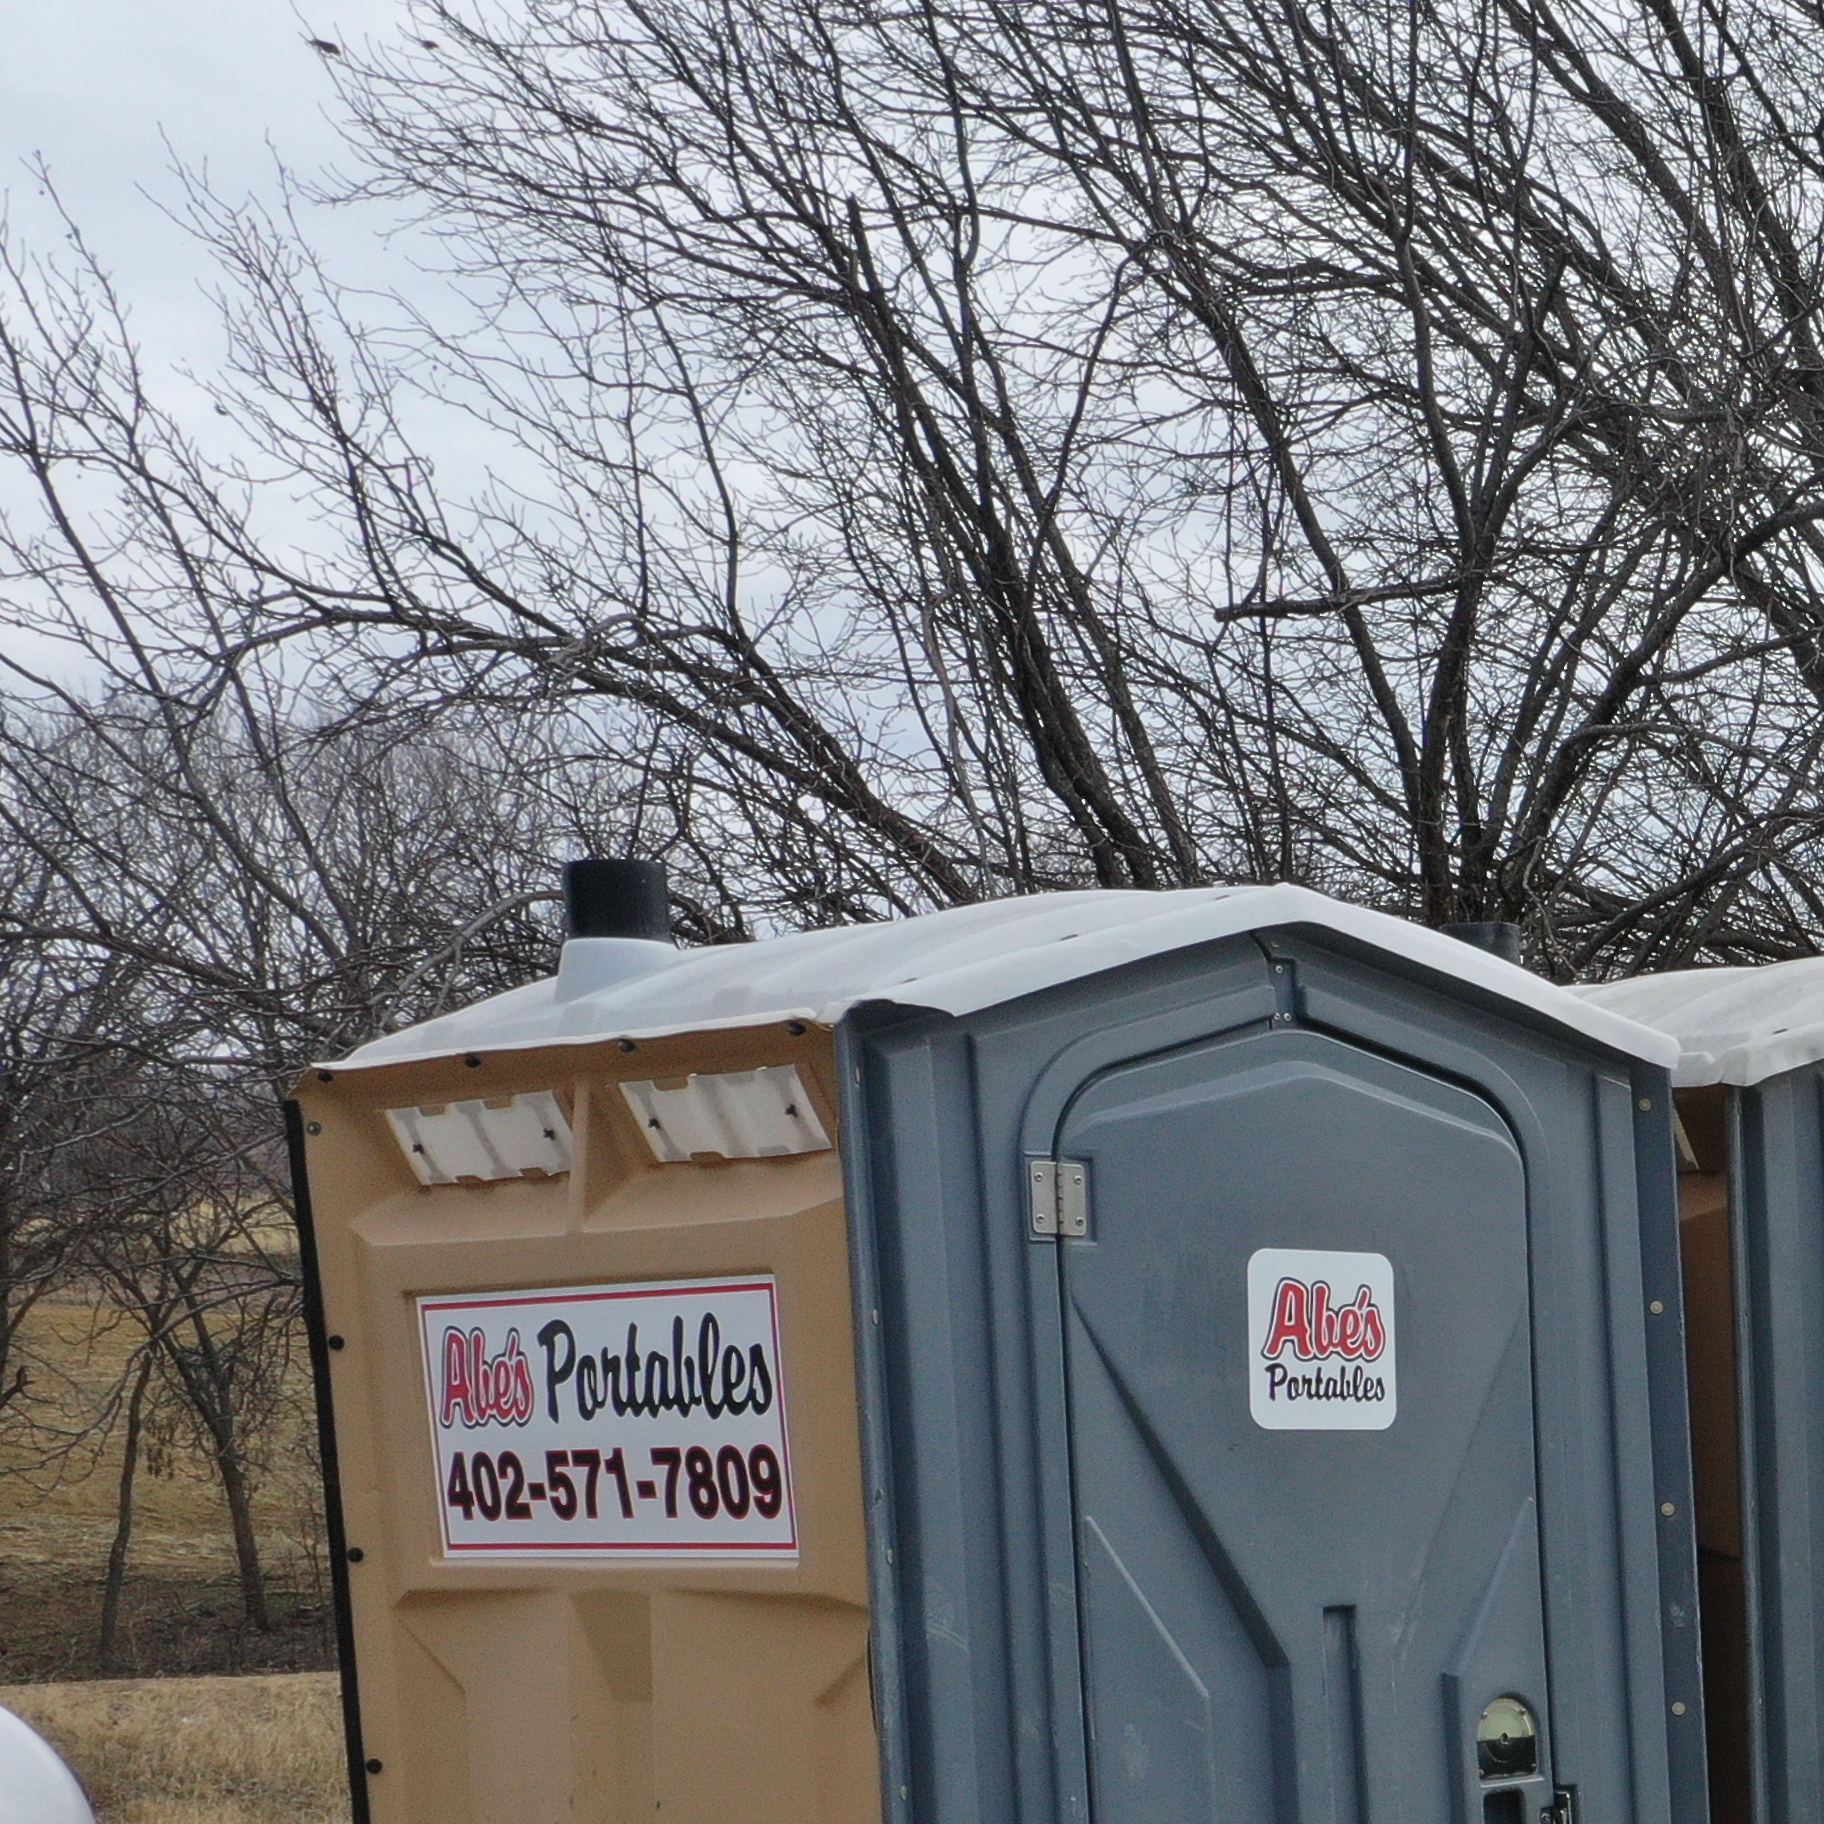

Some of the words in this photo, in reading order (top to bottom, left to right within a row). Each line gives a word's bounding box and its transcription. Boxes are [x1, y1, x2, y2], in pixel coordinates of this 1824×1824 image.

[1261, 1276, 1386, 1363] Abe's
[440, 1326, 534, 1428] Abe's
[537, 1311, 773, 1424] Portables
[1264, 1363, 1385, 1402] Portables
[447, 1443, 783, 1521] 402-571-7809
